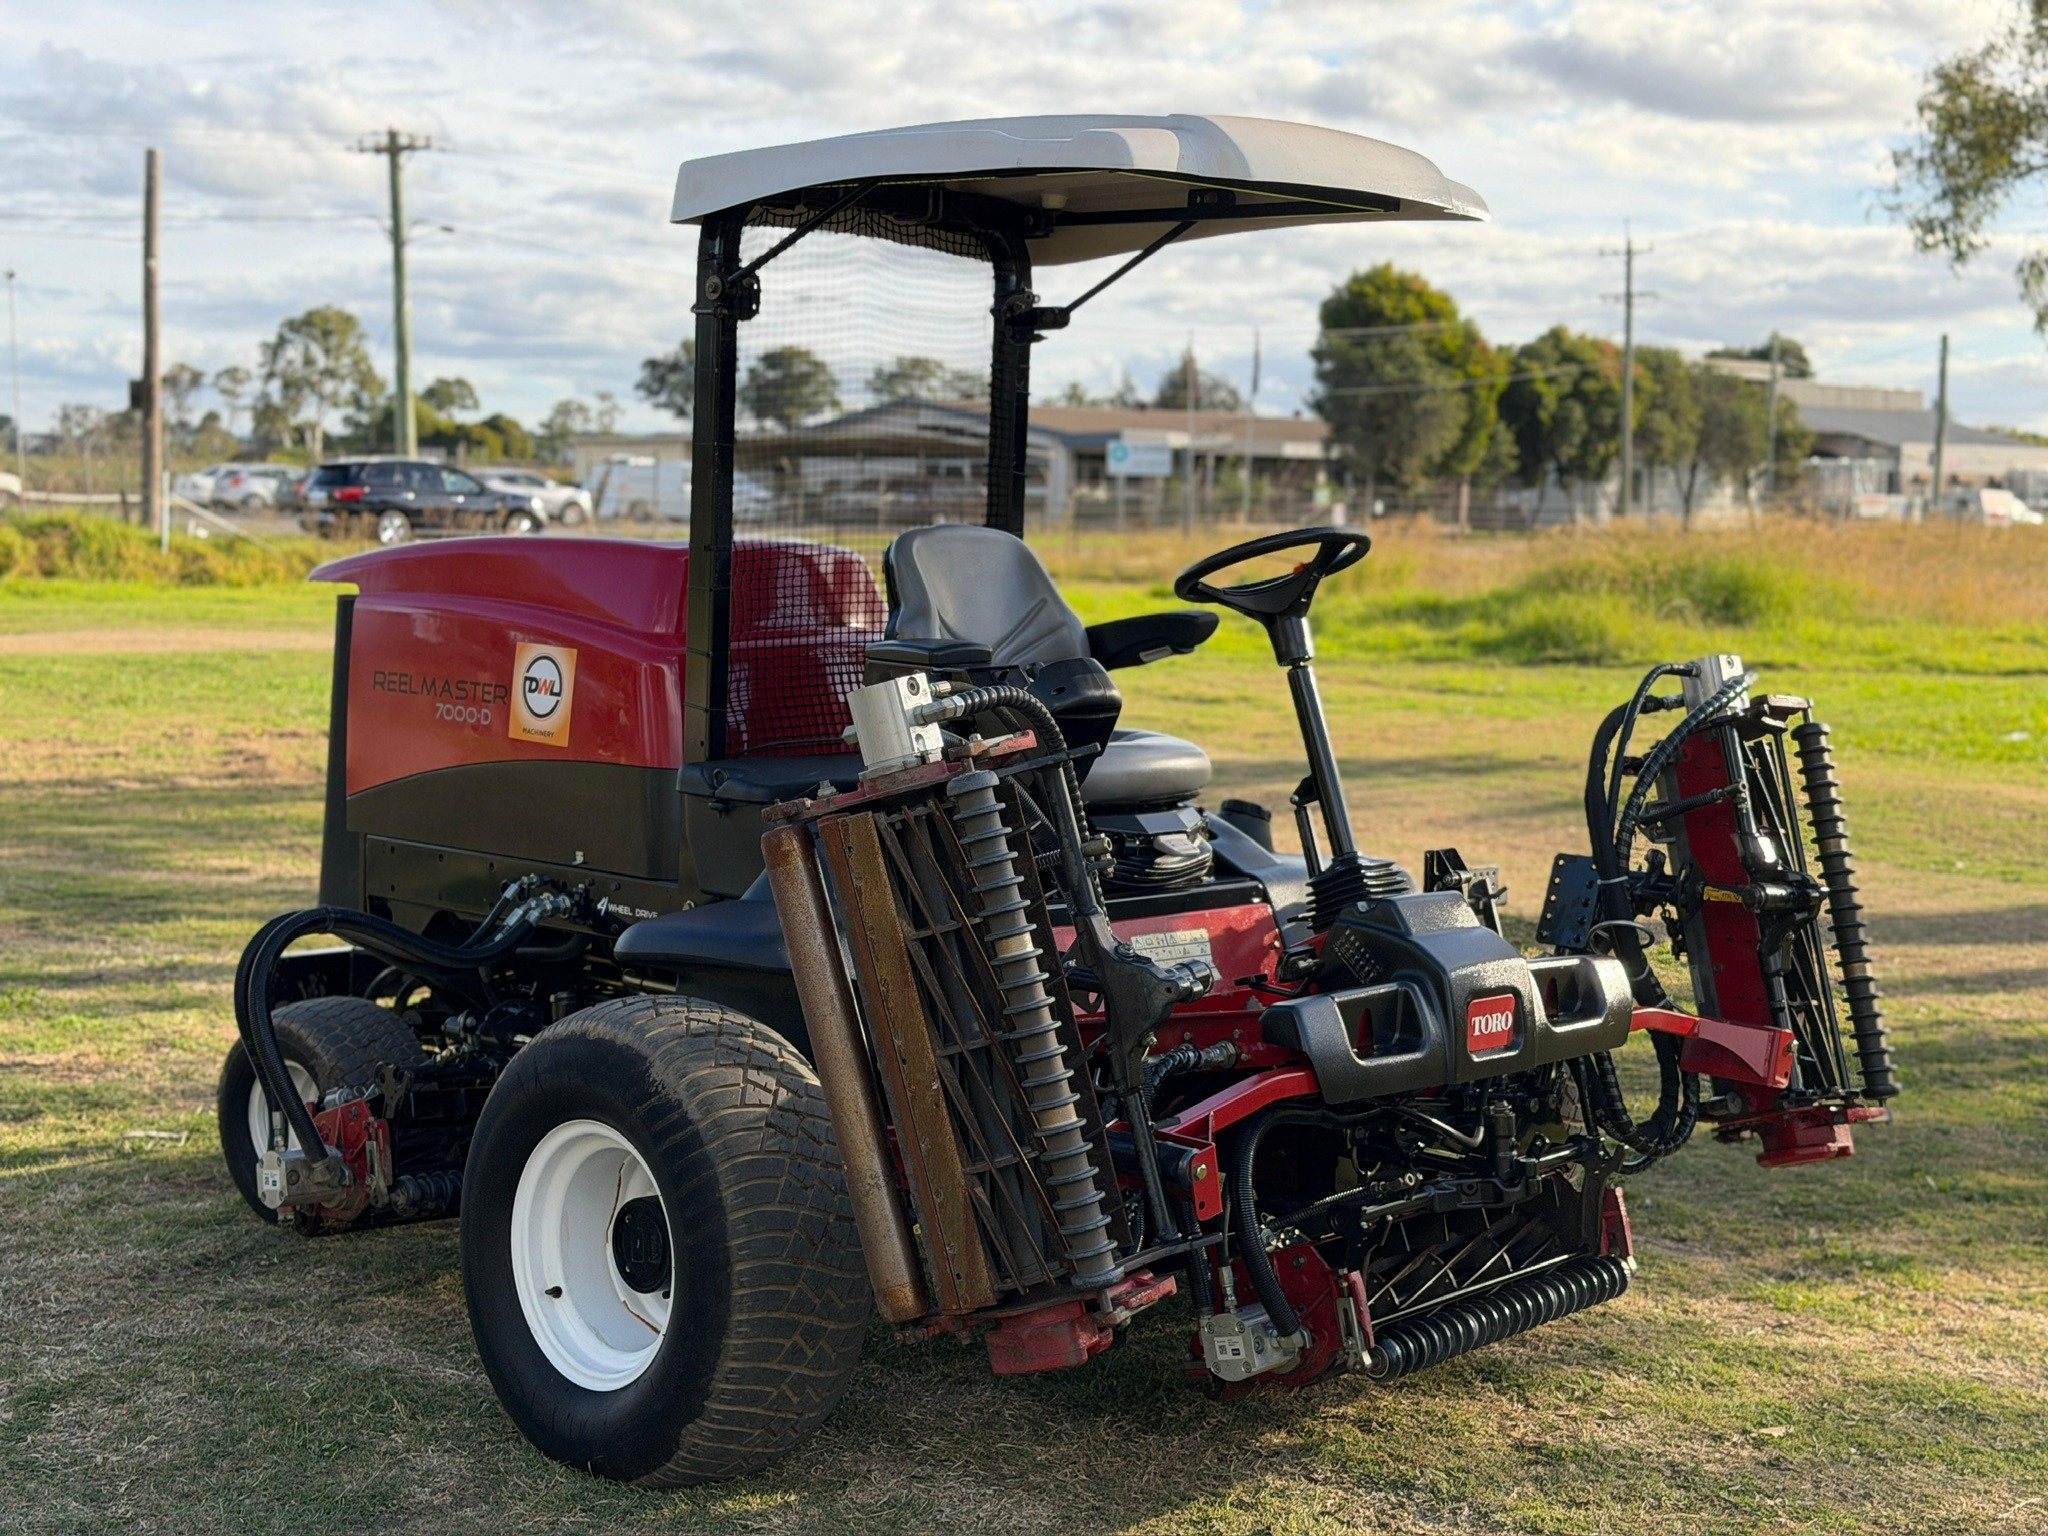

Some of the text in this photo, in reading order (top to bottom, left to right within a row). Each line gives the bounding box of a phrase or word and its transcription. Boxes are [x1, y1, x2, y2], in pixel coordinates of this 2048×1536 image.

[373, 670, 508, 705] REELMASTER
[597, 896, 658, 919] 4 WHEEL DRIVE
[1471, 1010, 1513, 1037] TORO
